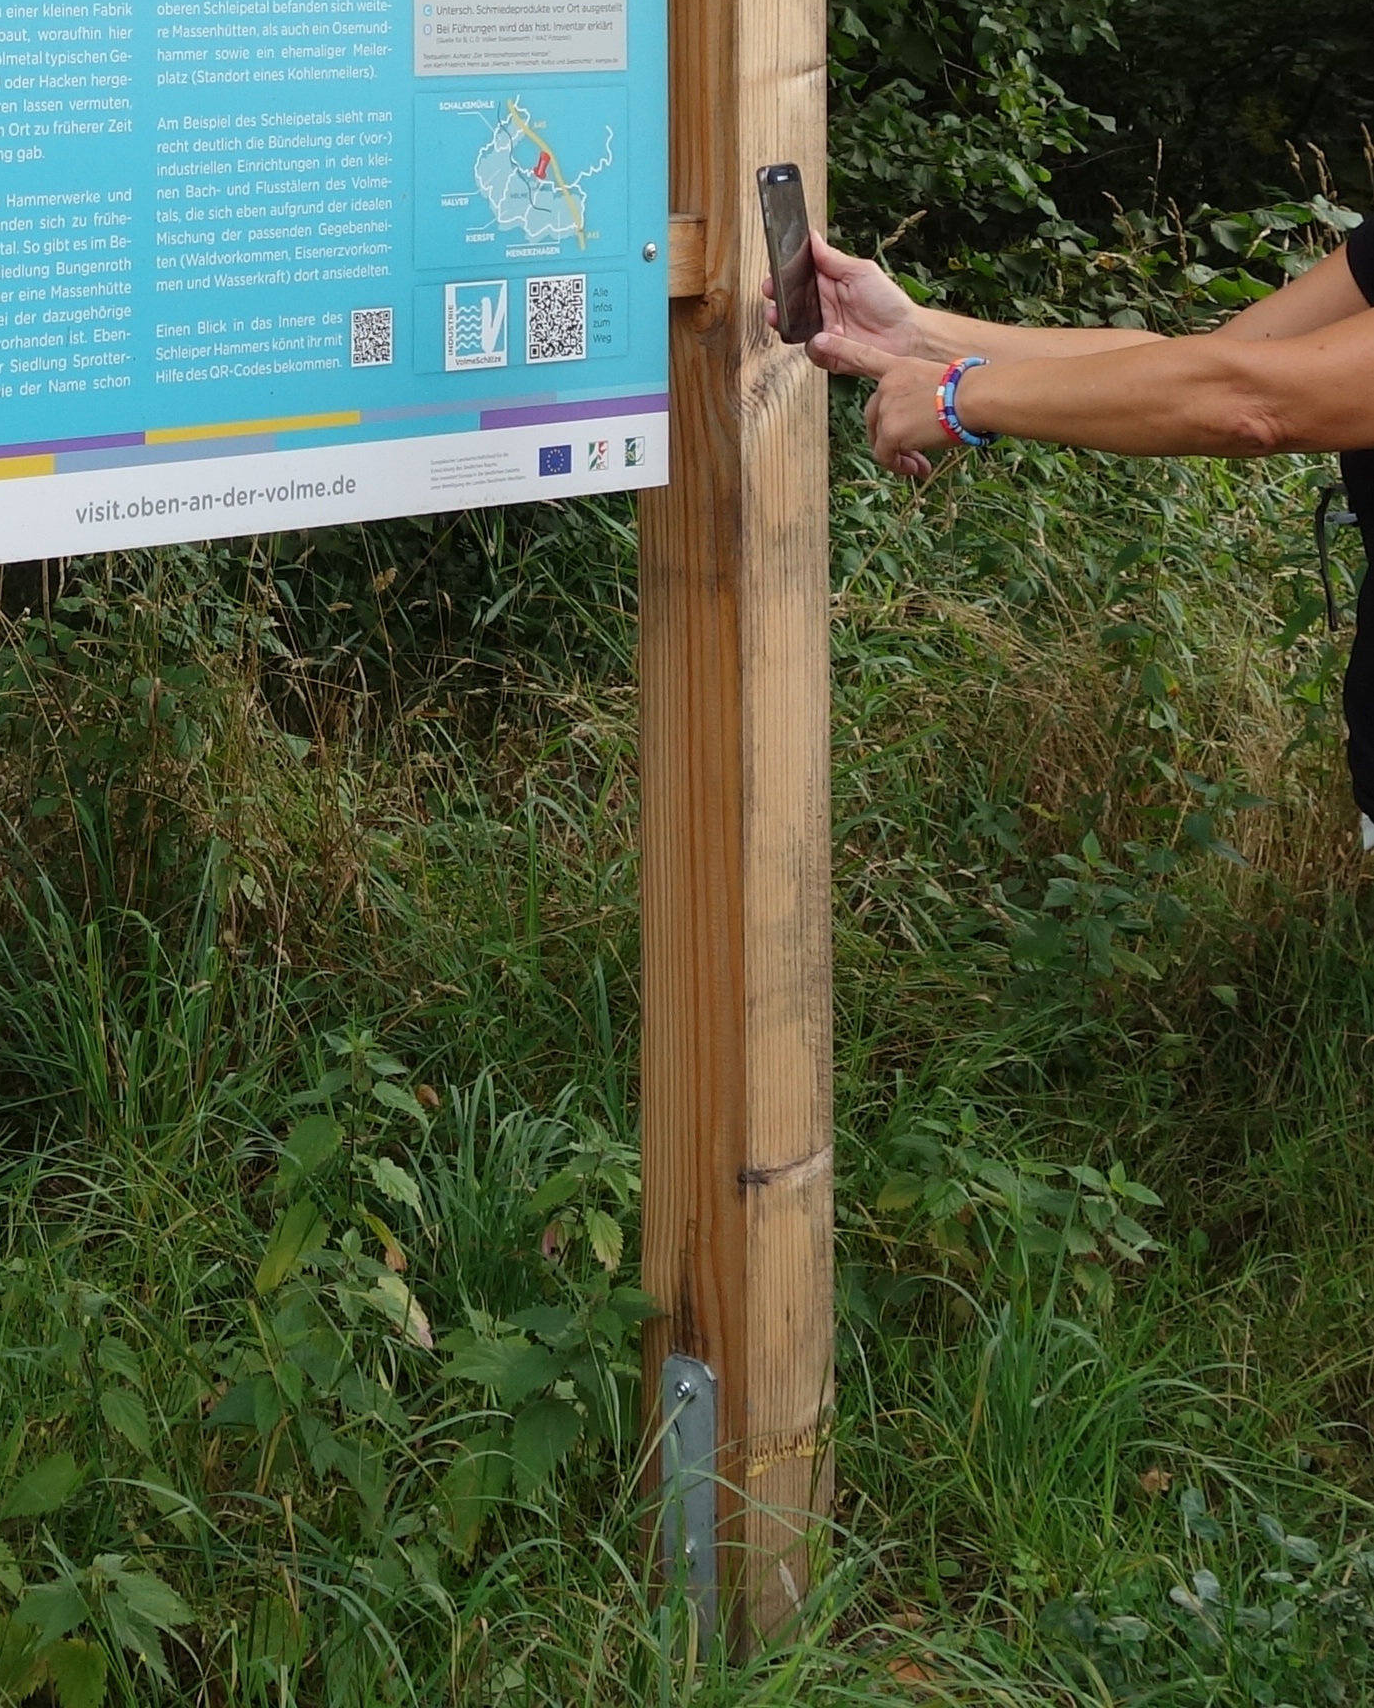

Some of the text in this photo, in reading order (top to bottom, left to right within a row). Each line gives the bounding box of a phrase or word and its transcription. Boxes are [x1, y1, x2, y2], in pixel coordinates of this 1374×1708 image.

[6, 5, 38, 18] einer
[43, 4, 88, 17] kleinen
[93, 3, 132, 16] Fabrik
[7, 190, 100, 207] Hammerwerke
[108, 188, 131, 202] und
[441, 197, 469, 207] HALVER
[593, 303, 613, 313] Infos
[157, 311, 342, 338] Einen Blick in das Innere des
[593, 319, 611, 328] zum
[593, 333, 612, 344] Weg
[76, 475, 356, 524] visit.oben-an-der-volme.de
